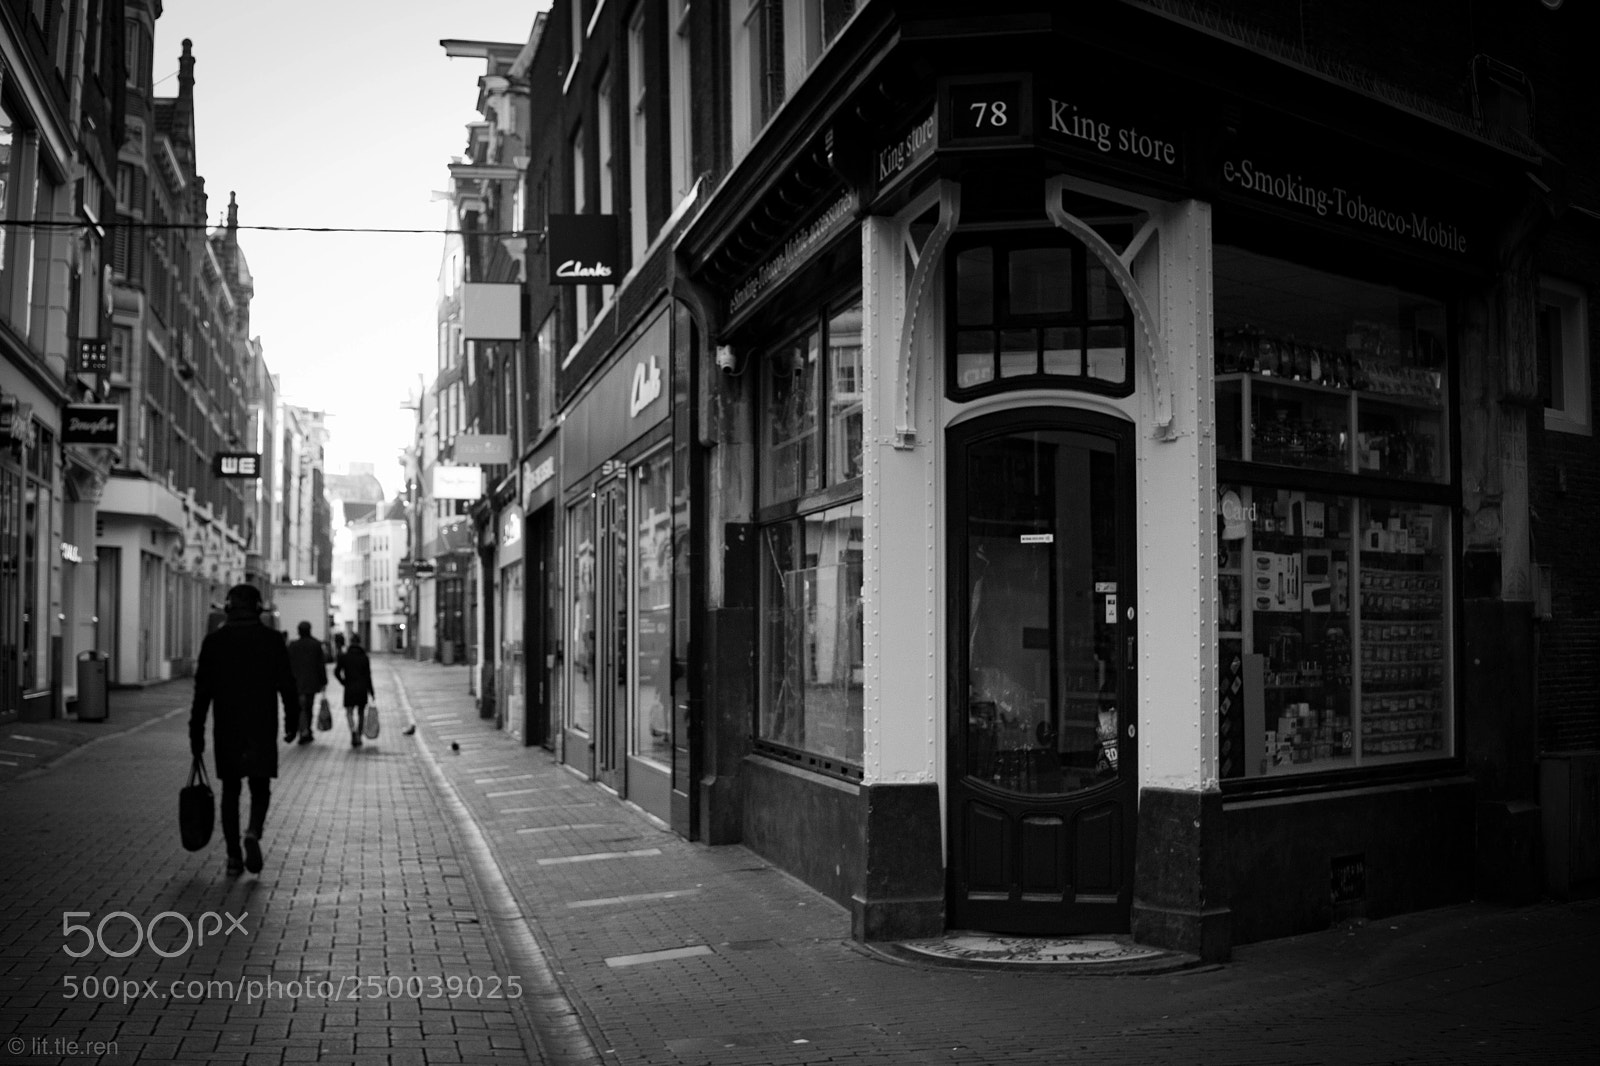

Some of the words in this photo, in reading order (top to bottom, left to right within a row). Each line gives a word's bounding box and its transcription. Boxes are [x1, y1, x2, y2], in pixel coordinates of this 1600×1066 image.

[969, 100, 1008, 128] 78
[1048, 98, 1111, 152] King
[1119, 125, 1176, 165] store
[879, 137, 905, 181] King
[906, 114, 934, 156] store
[1223, 159, 1467, 253] e-Smoking-Tobacco-Mobile
[555, 260, 612, 277] Clarks
[221, 457, 256, 475] WE
[1222, 500, 1256, 521] Card
